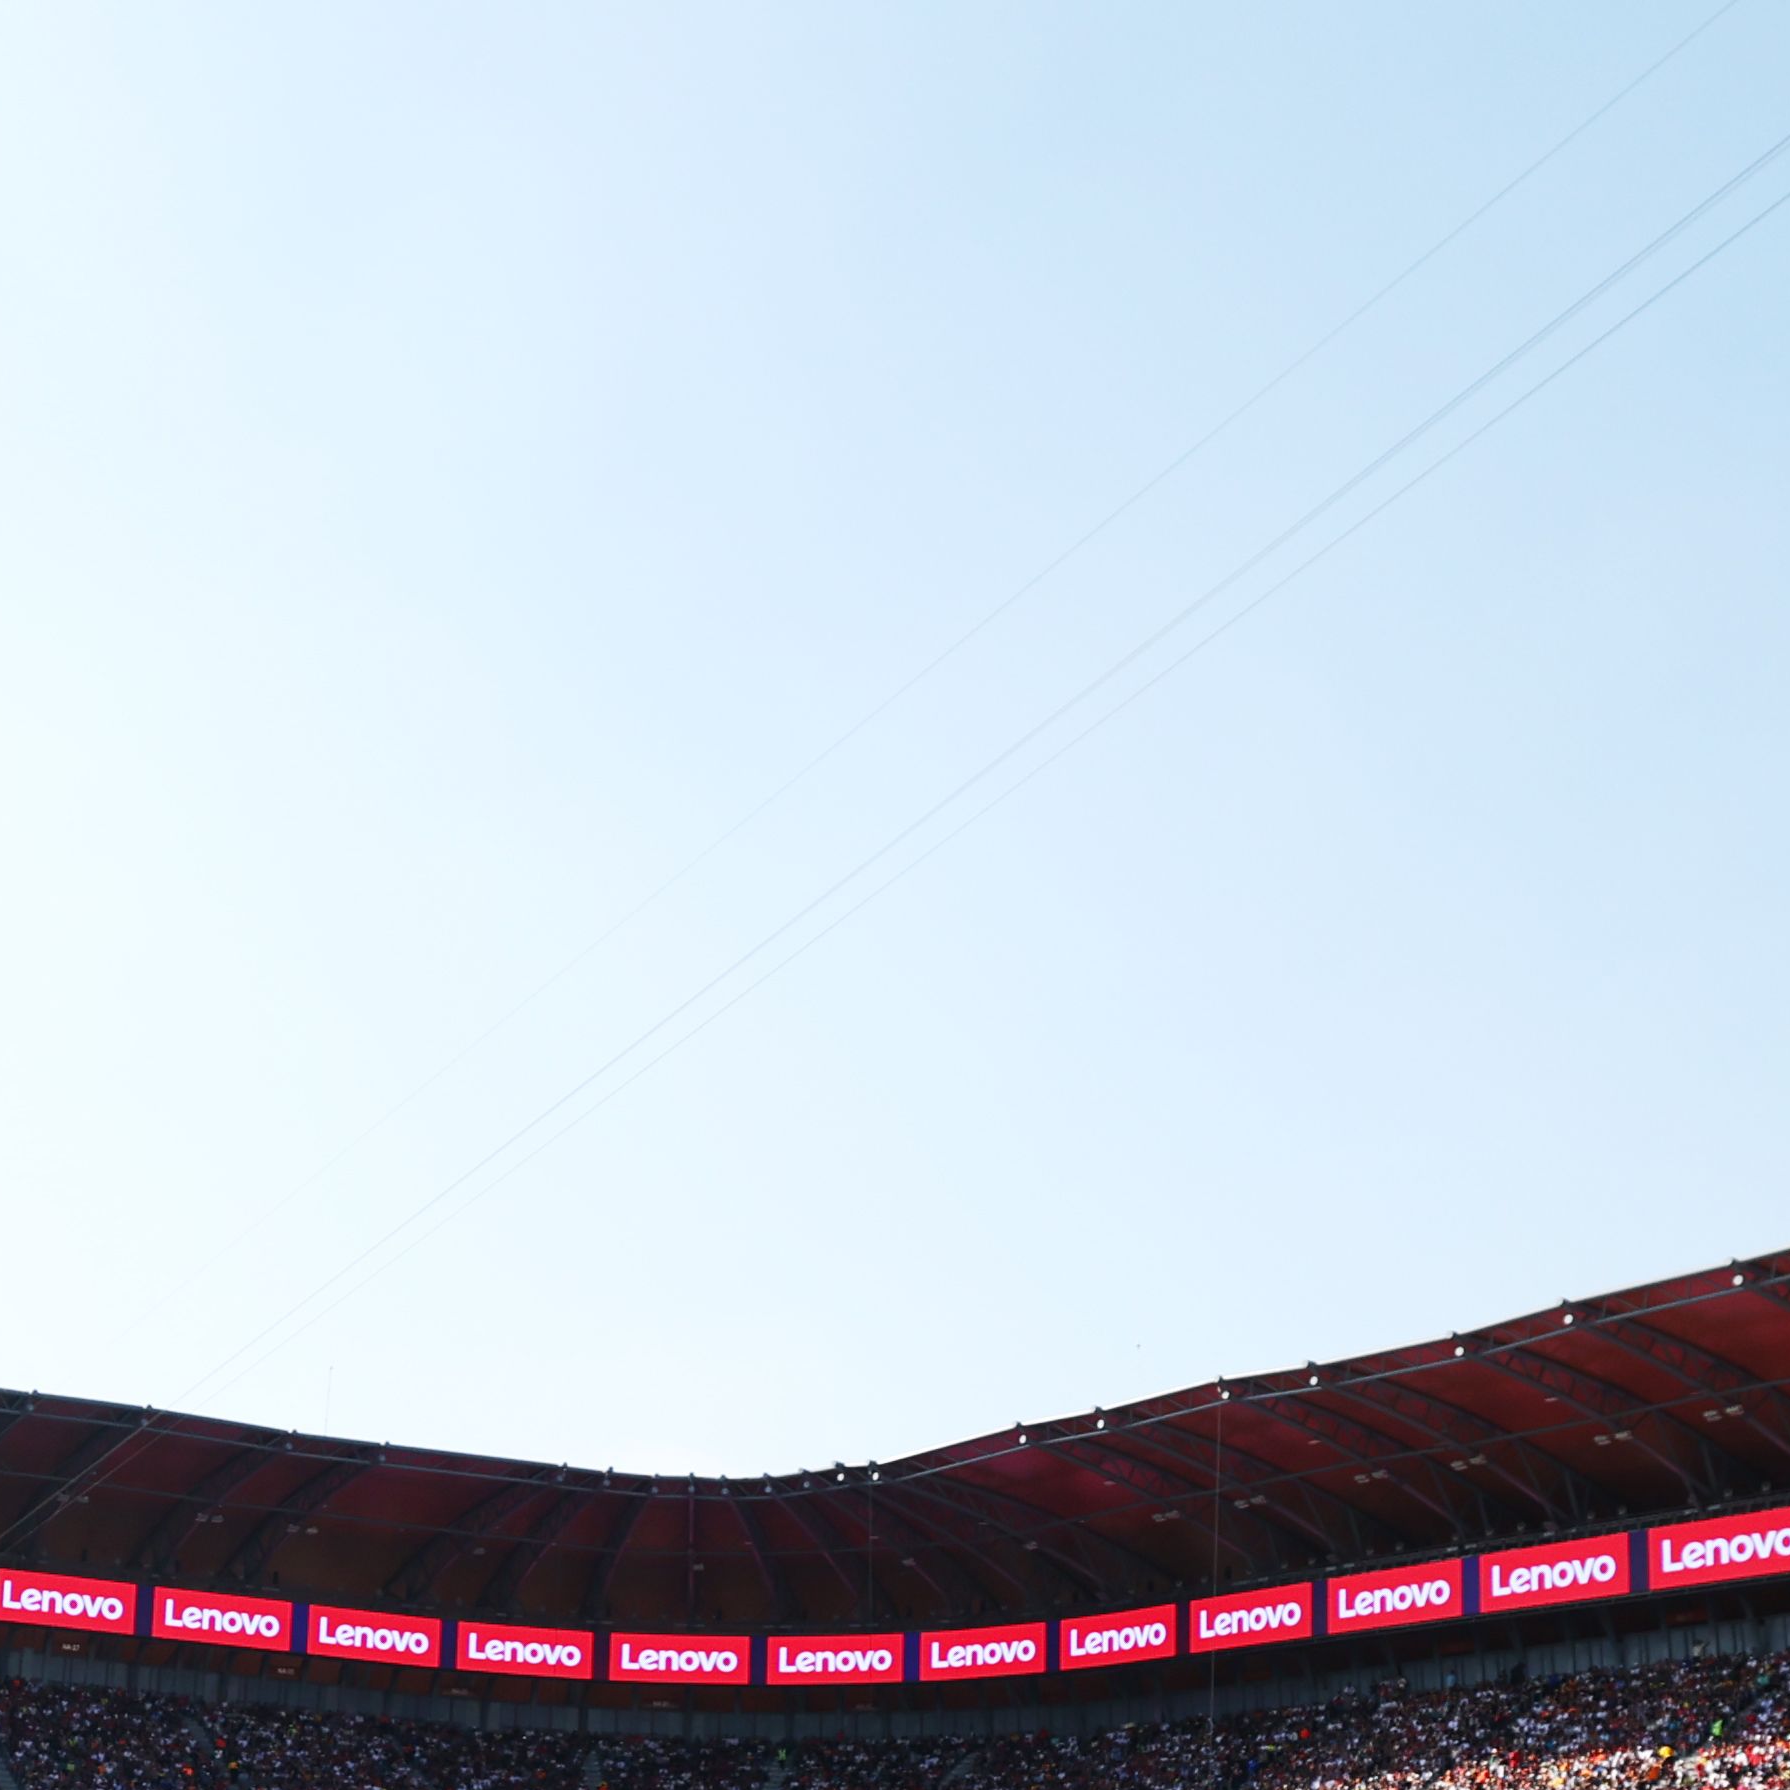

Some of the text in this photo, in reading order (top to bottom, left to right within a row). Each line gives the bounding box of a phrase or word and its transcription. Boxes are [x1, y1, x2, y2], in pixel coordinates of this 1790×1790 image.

[1491, 1555, 1616, 1597] Lenovo
[2, 1579, 124, 1620] Lenovo
[1338, 1579, 1451, 1619] Lenovo
[164, 1598, 280, 1638] Lenovo
[319, 1616, 429, 1654] Lenovo
[1199, 1602, 1302, 1638] Lenovo
[468, 1632, 582, 1667] Lenovo
[931, 1639, 1036, 1669] Lenovo
[1070, 1622, 1167, 1657] Lenovo
[621, 1643, 738, 1673] Lenovo
[778, 1646, 893, 1673] Lenovo
